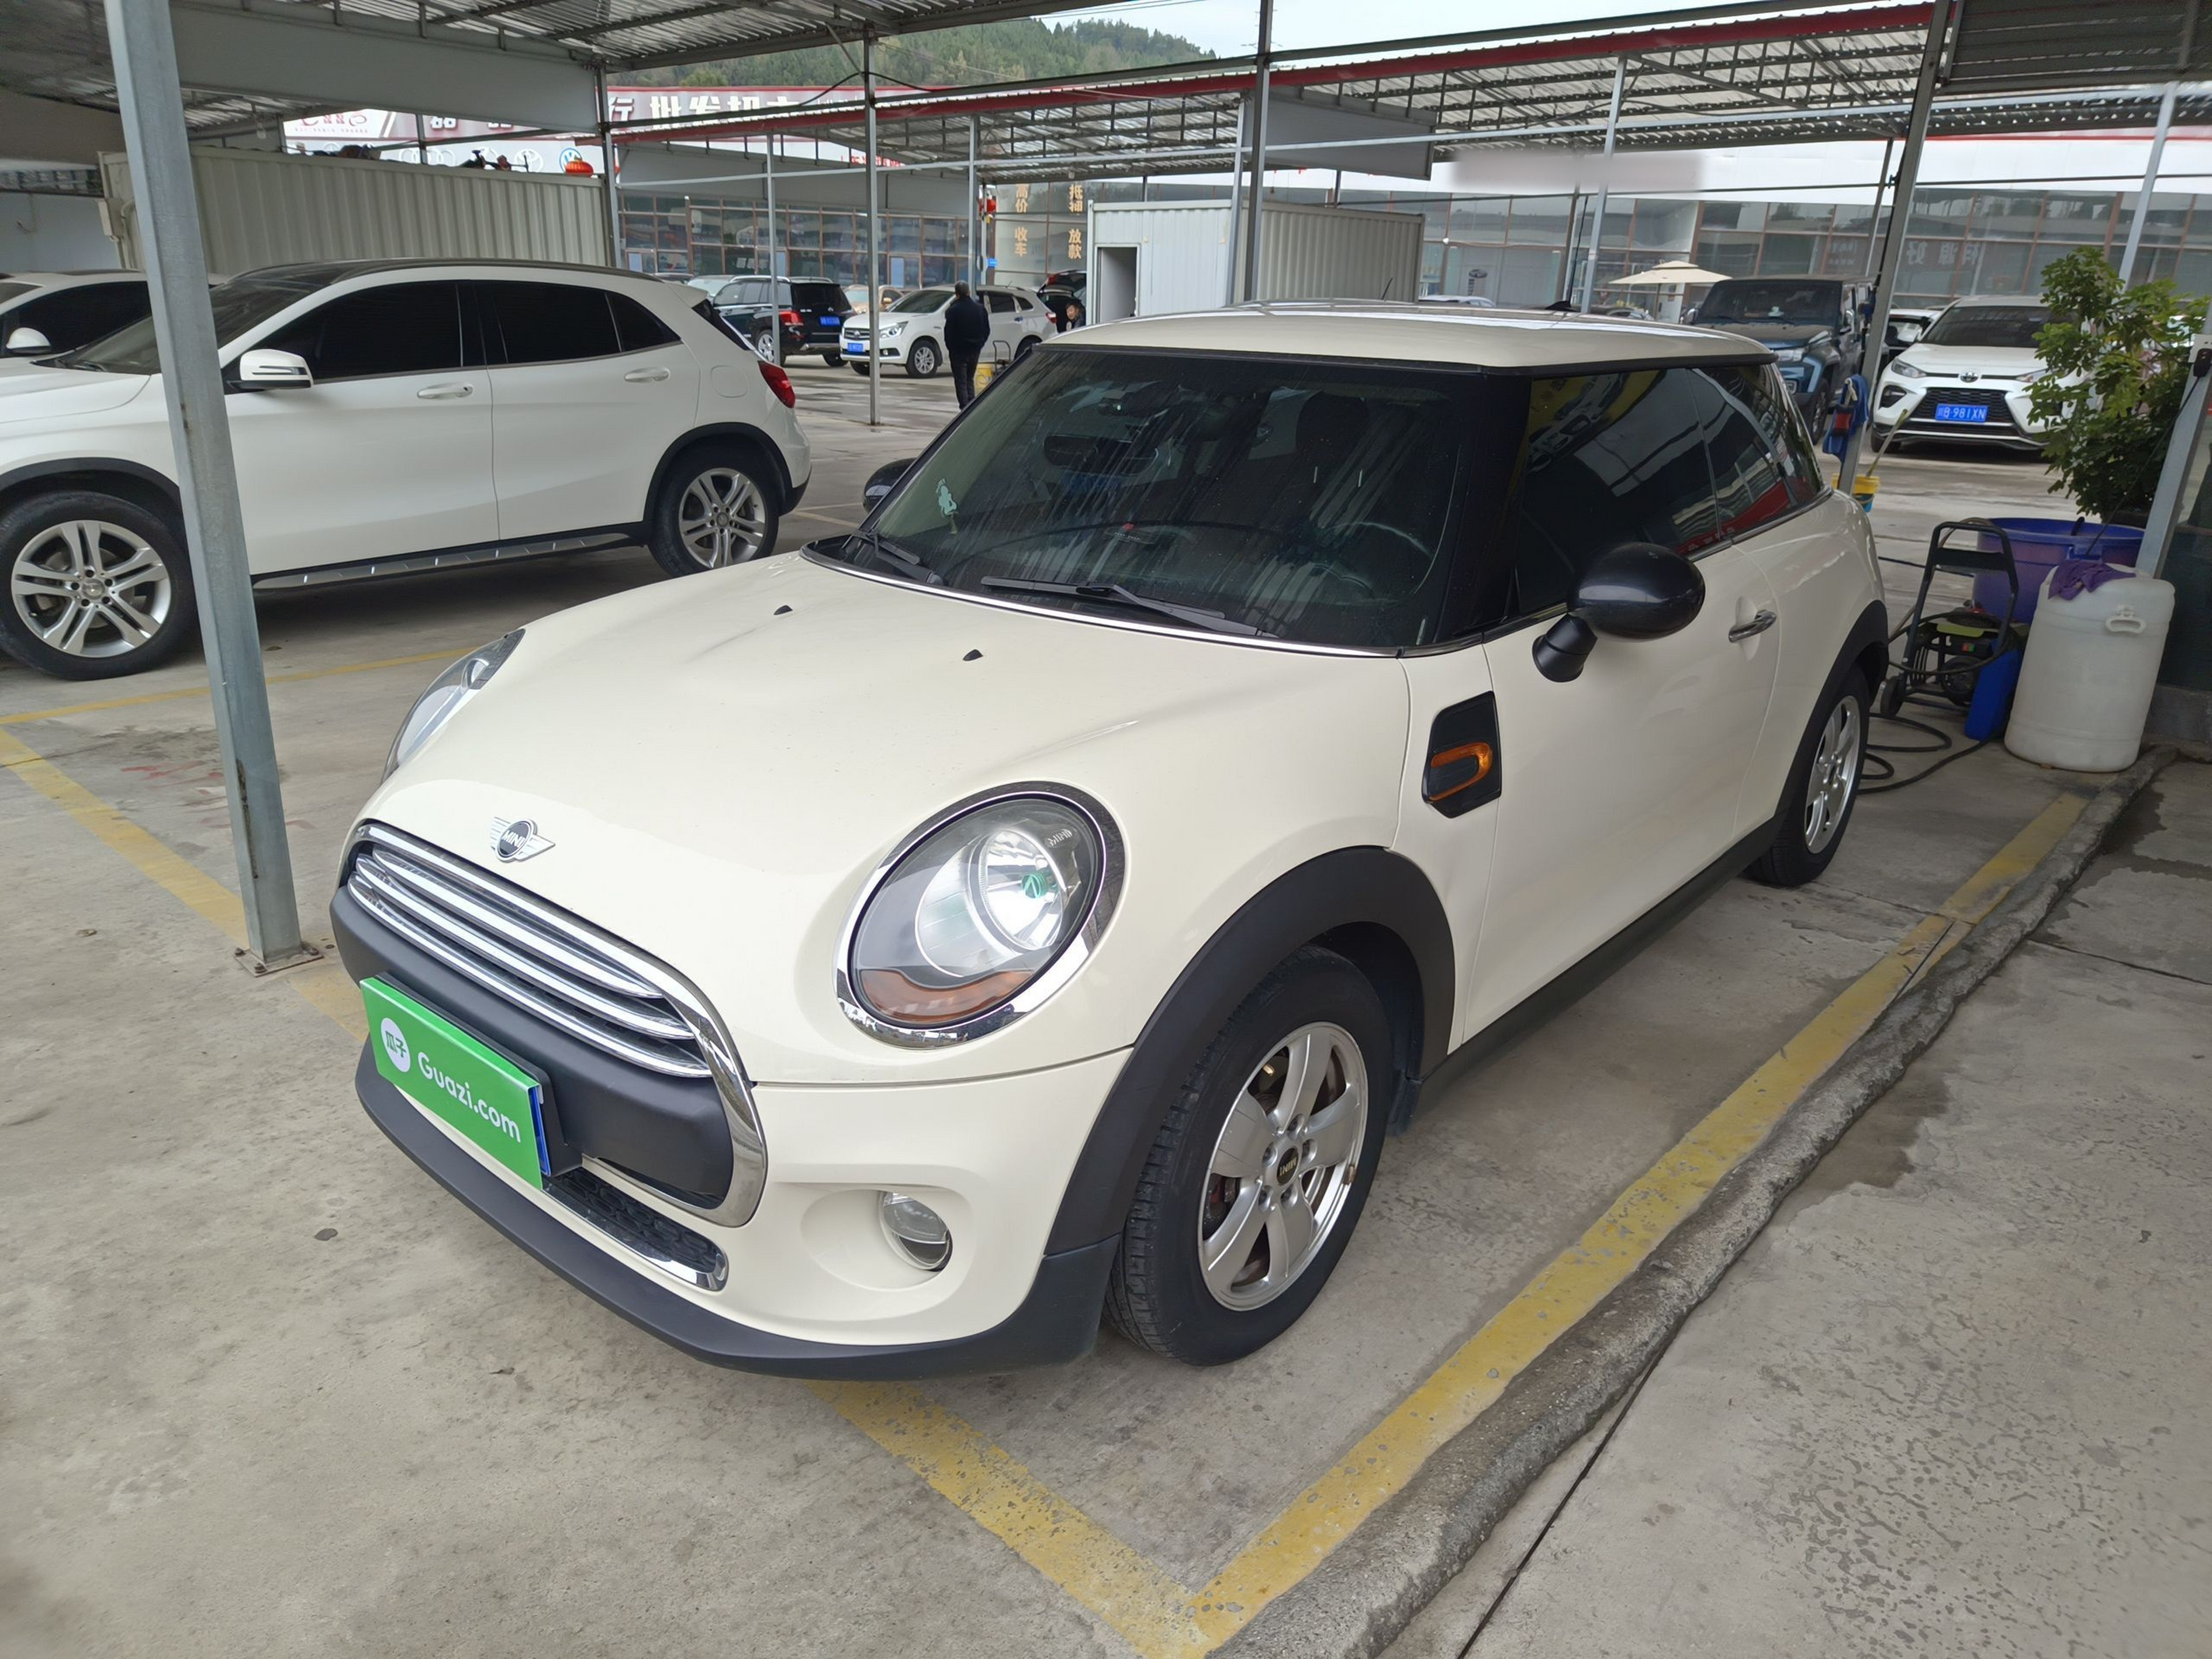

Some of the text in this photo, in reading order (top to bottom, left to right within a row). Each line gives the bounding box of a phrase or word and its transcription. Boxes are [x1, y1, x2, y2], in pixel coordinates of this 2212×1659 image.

[501, 830, 527, 848] MINI
[385, 1031, 406, 1058] 瓜子
[418, 1052, 521, 1143] Guazi.com
[1279, 1157, 1297, 1176] MINI
